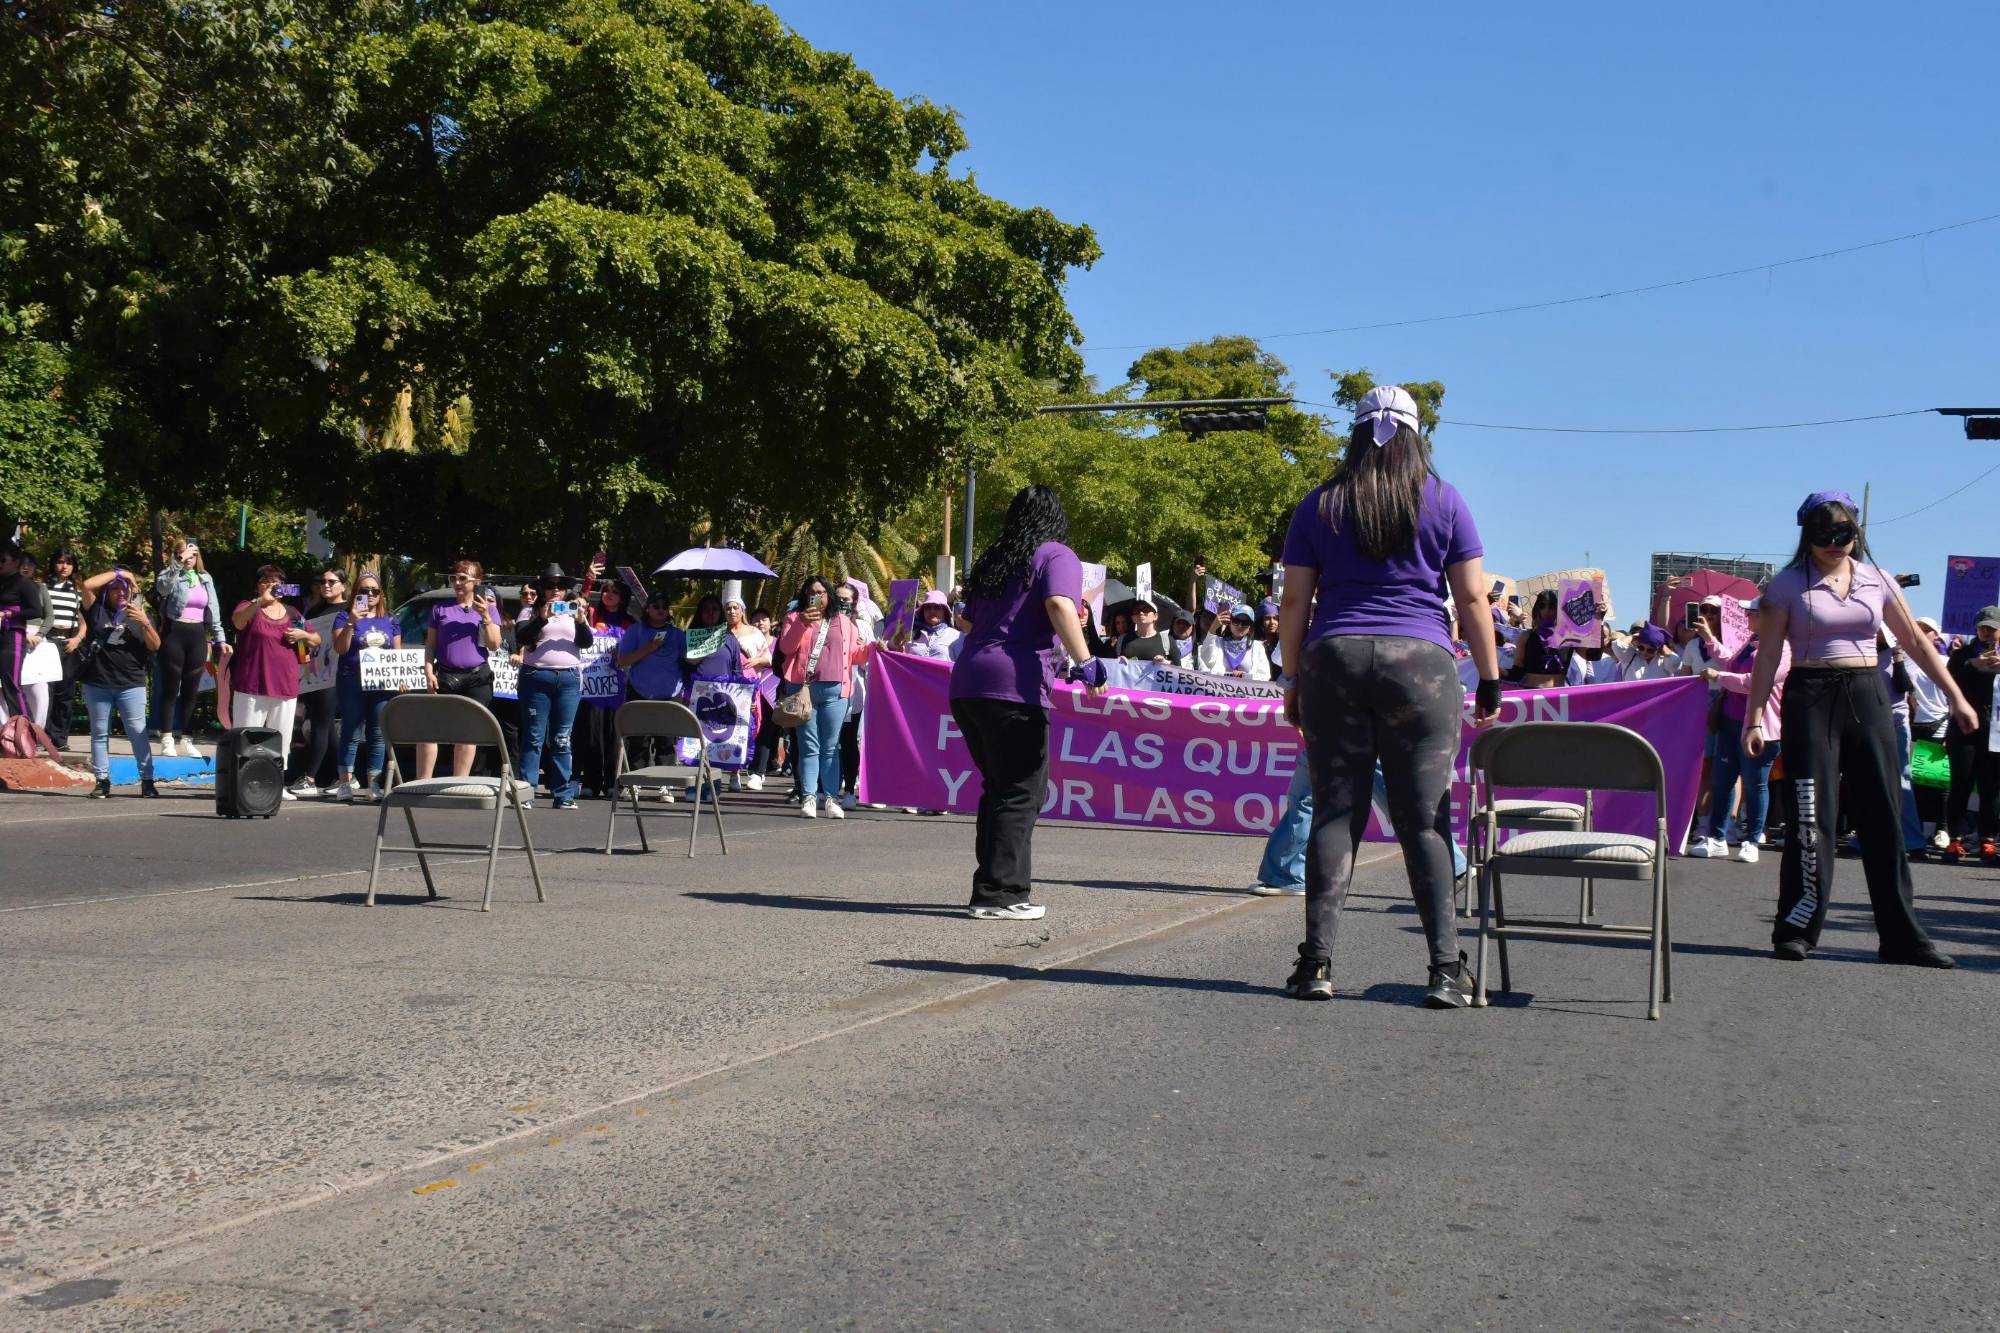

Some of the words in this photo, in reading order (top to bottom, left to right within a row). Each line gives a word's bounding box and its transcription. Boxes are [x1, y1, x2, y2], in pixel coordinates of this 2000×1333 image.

[380, 653, 397, 664] POR
[400, 652, 418, 664] LAS
[1156, 670, 1173, 684] SE
[1177, 671, 1285, 699] ESCANDALIZAN
[1071, 687, 1173, 722] LAS
[1059, 727, 1166, 770] LAS
[1183, 737, 1298, 777] QUE
[938, 768, 972, 806] Y
[1113, 784, 1216, 827] LAS
[1795, 778, 1816, 822] HIGH
